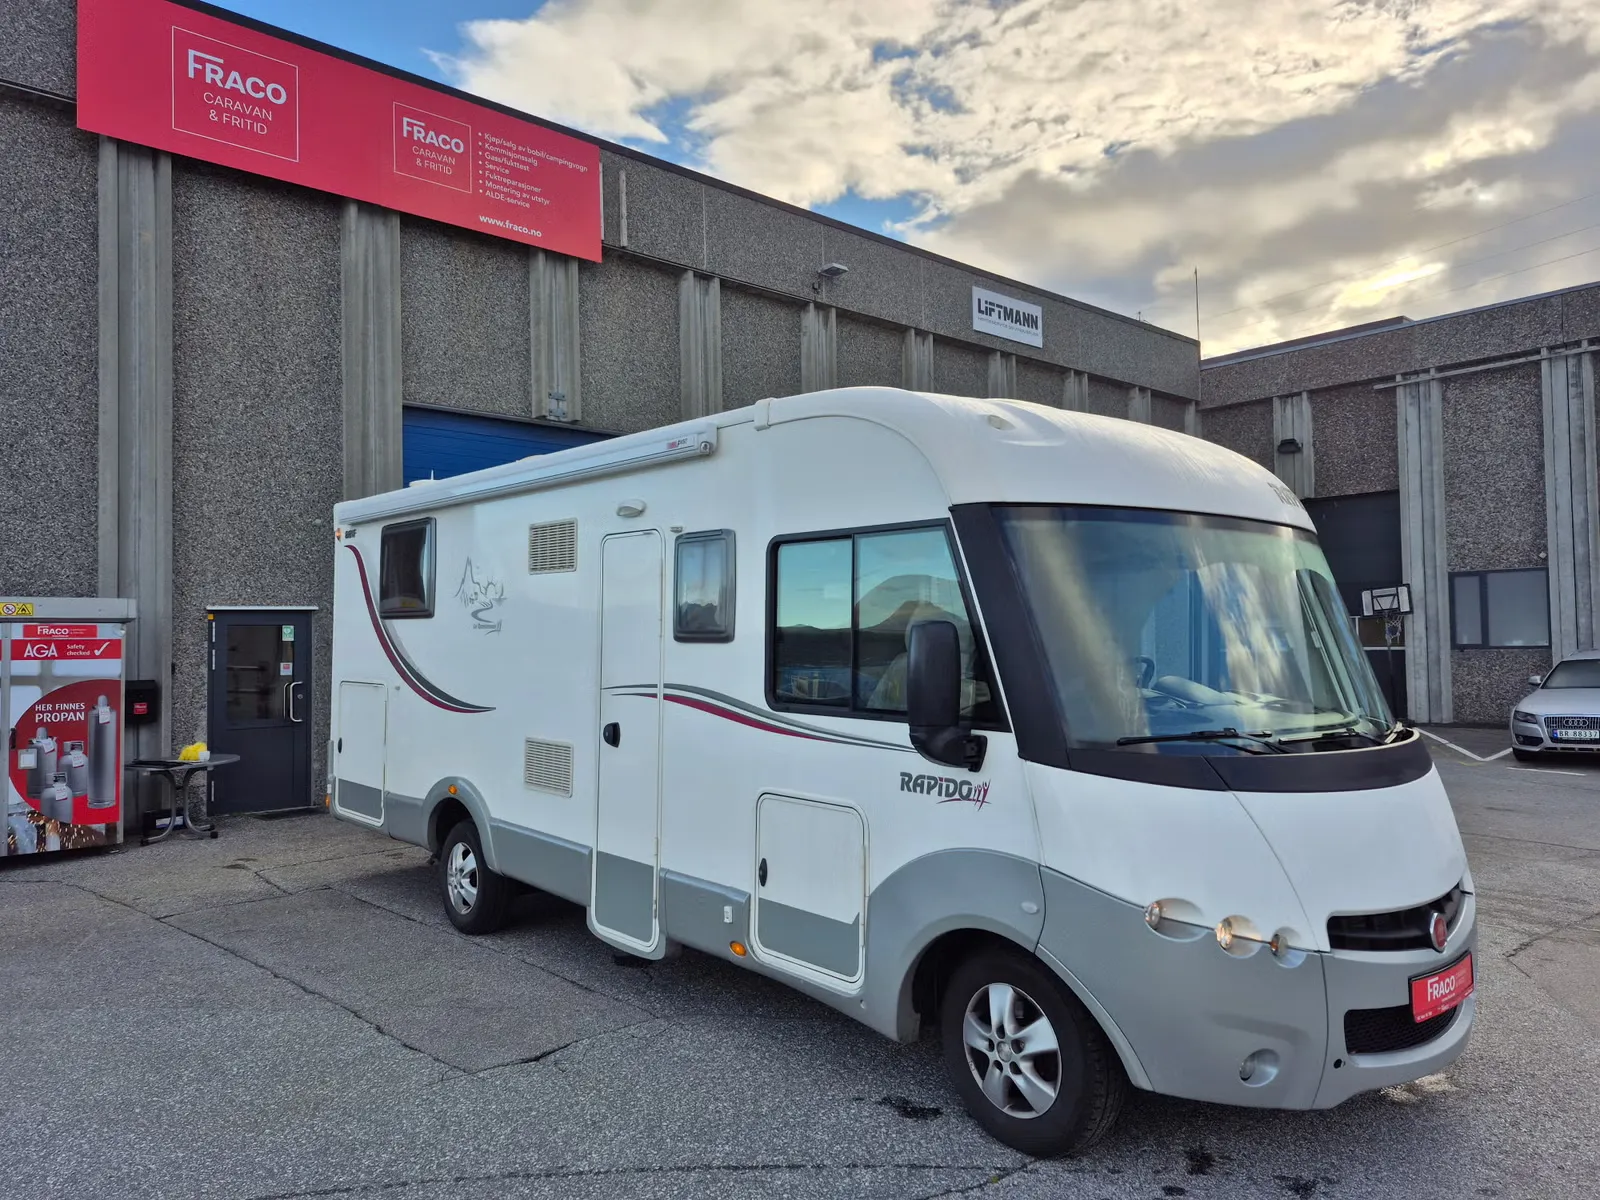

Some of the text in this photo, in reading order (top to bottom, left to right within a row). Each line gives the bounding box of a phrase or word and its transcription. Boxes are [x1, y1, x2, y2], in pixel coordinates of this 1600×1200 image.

[188, 49, 287, 105] FRACO
[203, 92, 272, 121] CARAVAN
[209, 109, 267, 135] & FRITID
[402, 116, 464, 154] FRACO
[412, 145, 456, 165] CARAVAN
[484, 133, 517, 150] Kjøp/salg
[526, 146, 588, 172] bobil/campingvogn
[484, 142, 538, 167] Kommisjonssalg
[484, 151, 530, 172] Gass/fukttest
[416, 157, 453, 175] & FRITID
[484, 161, 510, 175] Service
[485, 170, 542, 193] Fuktreparasjoner
[485, 180, 521, 197] Montering
[531, 194, 550, 205] utstyr
[485, 190, 531, 208] ALDE-service
[479, 215, 542, 237] www.fraco.no
[37, 625, 69, 635] FRACO
[24, 642, 58, 658] AGA
[35, 702, 85, 711] HER FINNES
[35, 711, 85, 723] PROPAN
[1427, 975, 1456, 1002] FRACO
